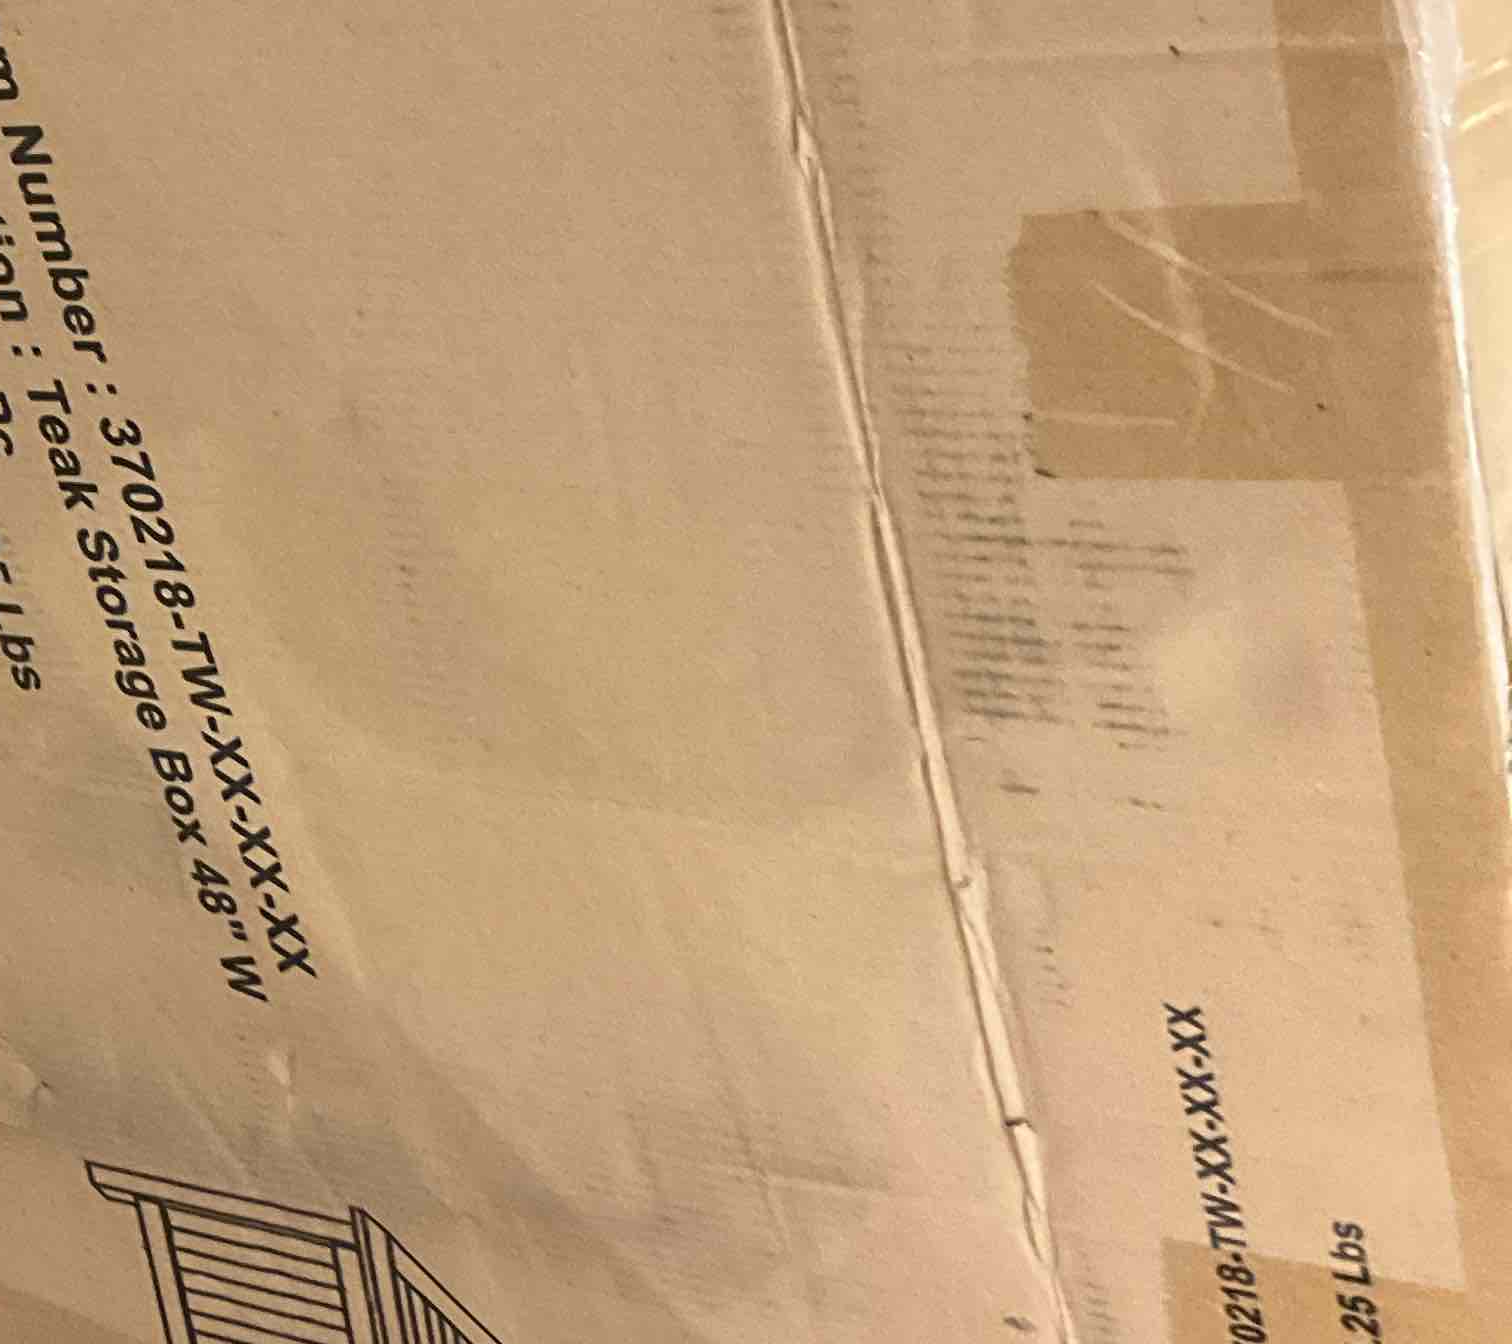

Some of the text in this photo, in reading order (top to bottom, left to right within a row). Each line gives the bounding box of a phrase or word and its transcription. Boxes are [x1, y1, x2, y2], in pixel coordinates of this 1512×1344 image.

[1, 124, 107, 364] Number
[99, 416, 318, 979] 370218-TW-XX-XX-XX
[26, 378, 99, 511] Teak
[76, 528, 168, 731] Storage
[149, 747, 208, 848] Box
[220, 955, 269, 1002] W
[1328, 1220, 1374, 1288] Lbs
